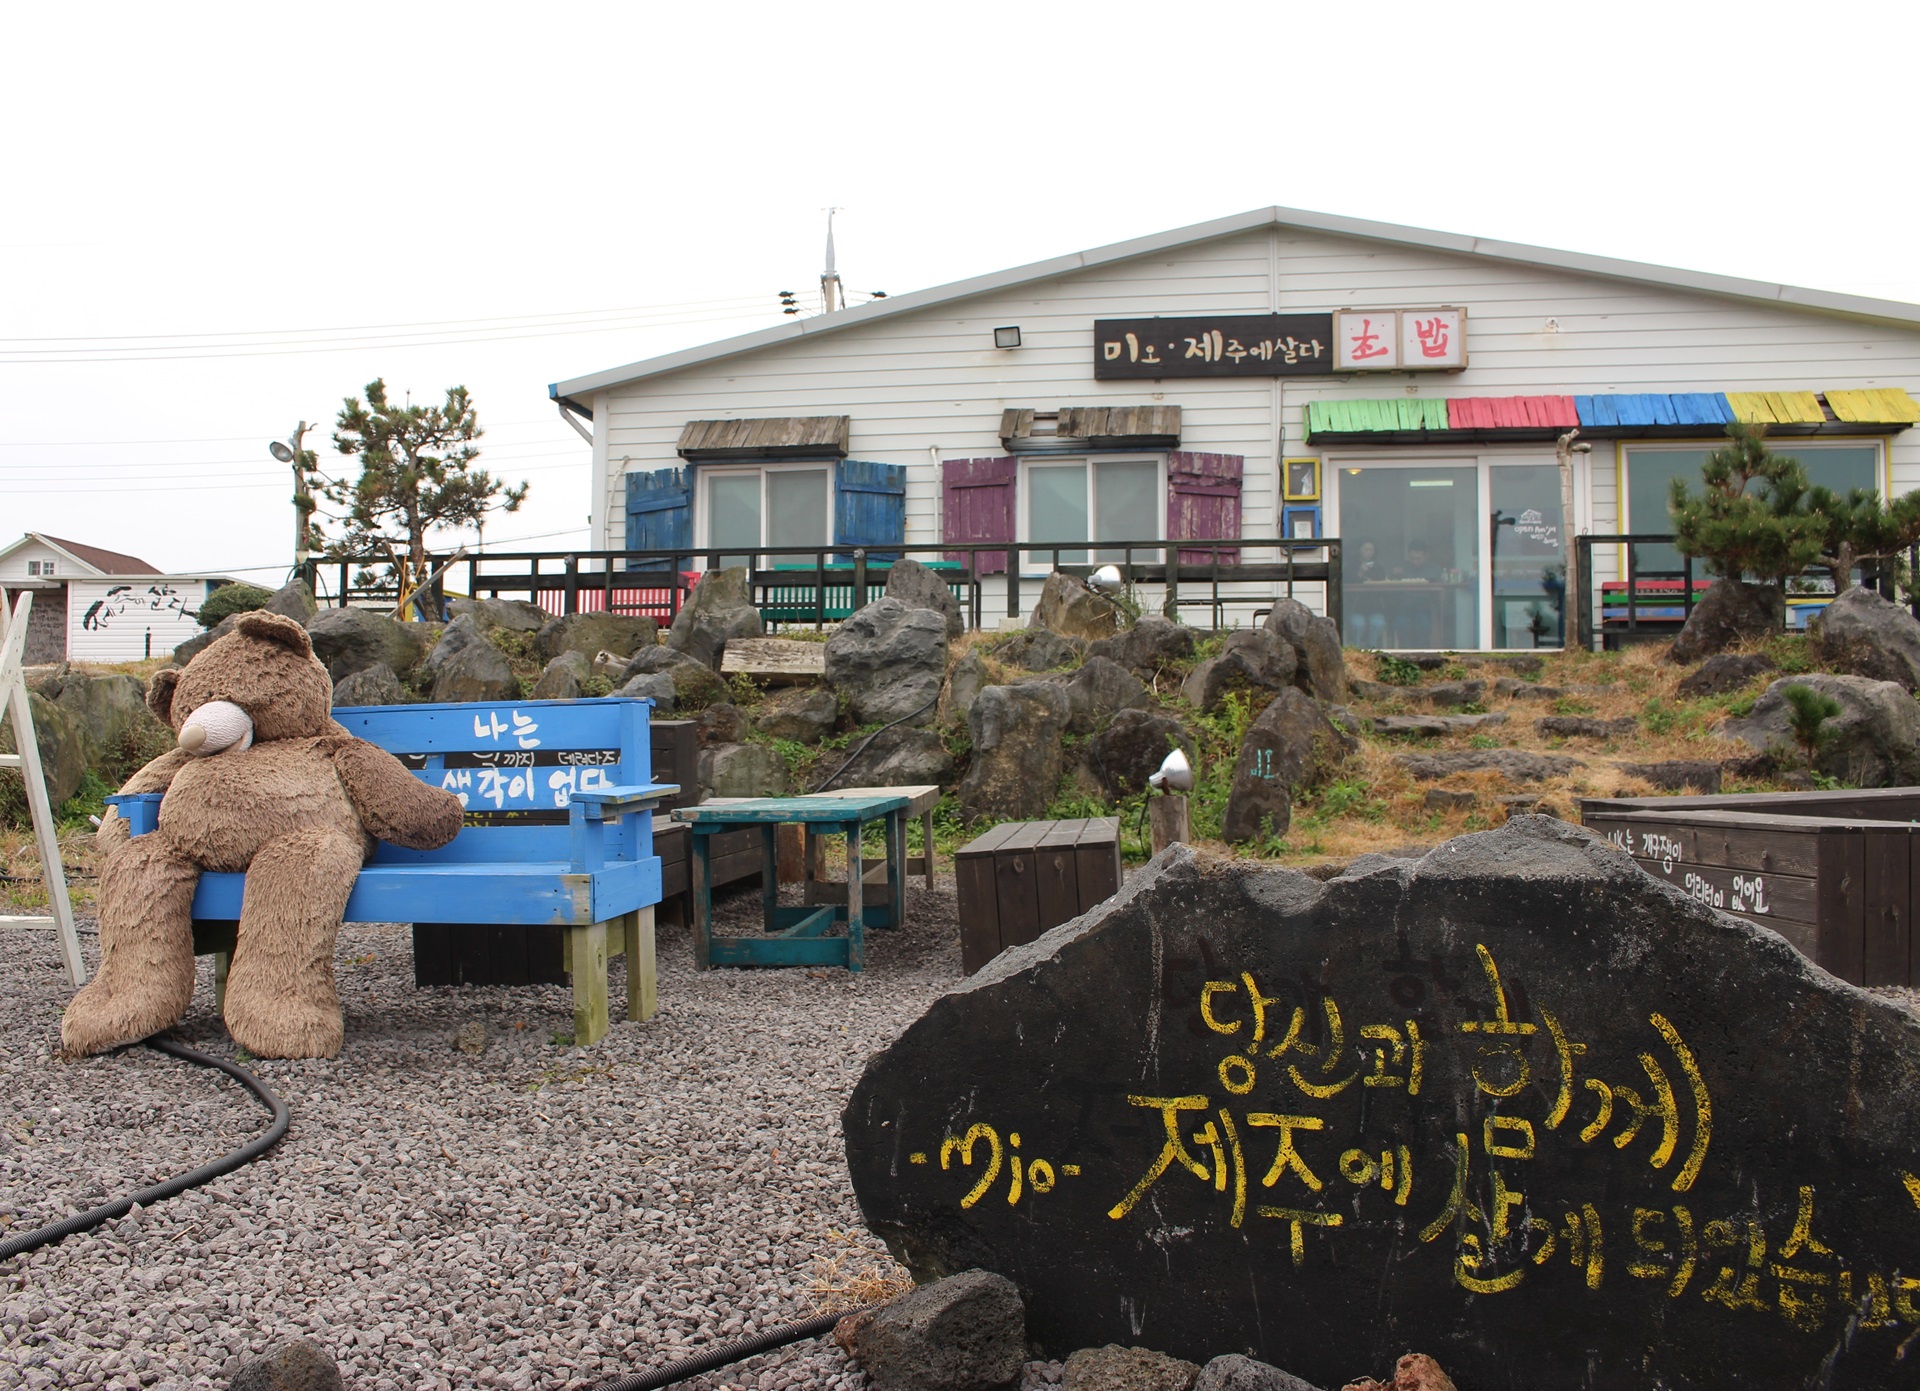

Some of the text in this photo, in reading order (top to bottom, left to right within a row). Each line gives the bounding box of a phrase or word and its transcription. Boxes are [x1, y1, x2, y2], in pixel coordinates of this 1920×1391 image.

[1351, 317, 1450, 360] 초밥
[474, 709, 542, 750] 나는
[442, 766, 617, 810] 생각이 없다
[1642, 833, 1683, 875] 개구쟁이
[1731, 875, 1770, 914] 없어요
[1201, 972, 1428, 1099] 당신과
[1455, 943, 1712, 1192] 함께
[1108, 1095, 1412, 1266] 제주에
